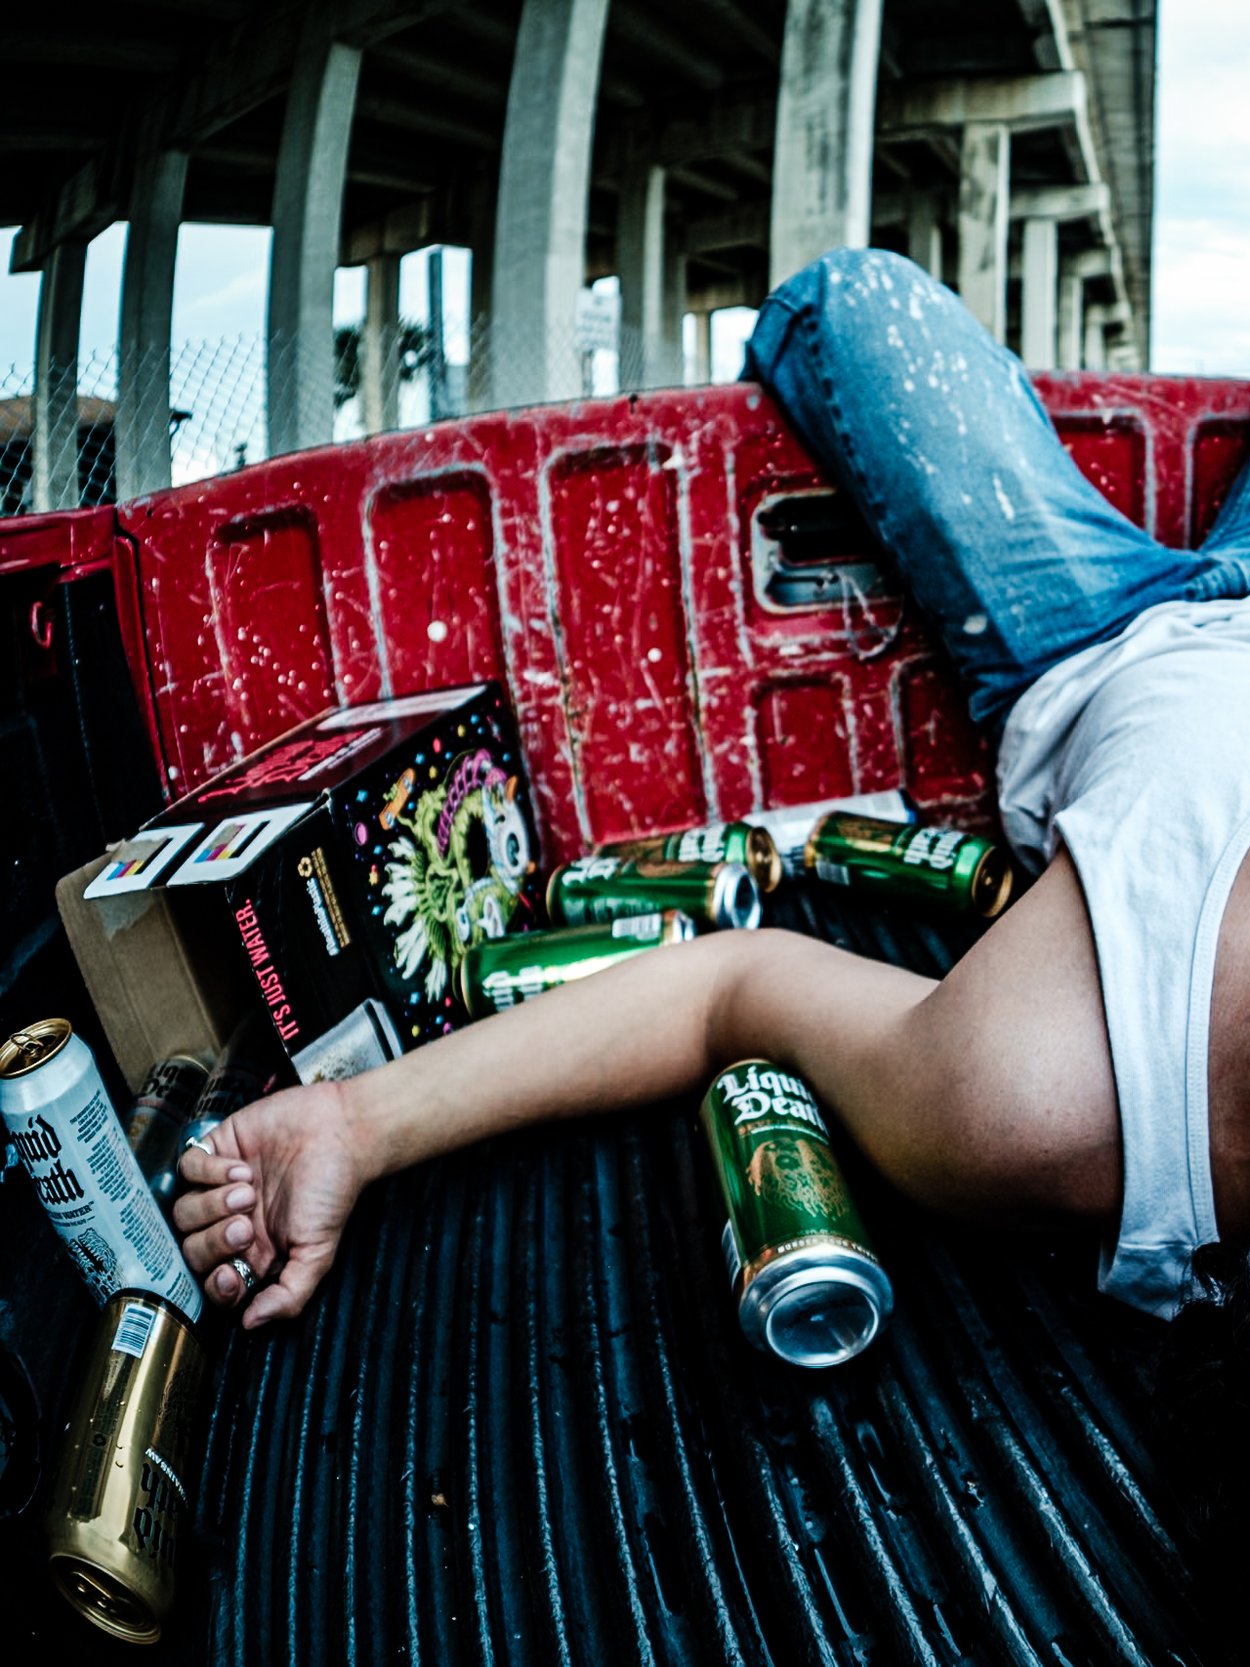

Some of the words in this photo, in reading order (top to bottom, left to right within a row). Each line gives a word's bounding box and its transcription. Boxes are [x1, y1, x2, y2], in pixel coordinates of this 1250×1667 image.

[233, 897, 270, 967] WATER.
[255, 964, 286, 1006] JUST
[271, 1002, 300, 1040] IT'S
[717, 1065, 814, 1104] Liqui
[731, 1090, 830, 1138] Deat
[11, 1113, 61, 1176] quid
[32, 1158, 84, 1203] eath
